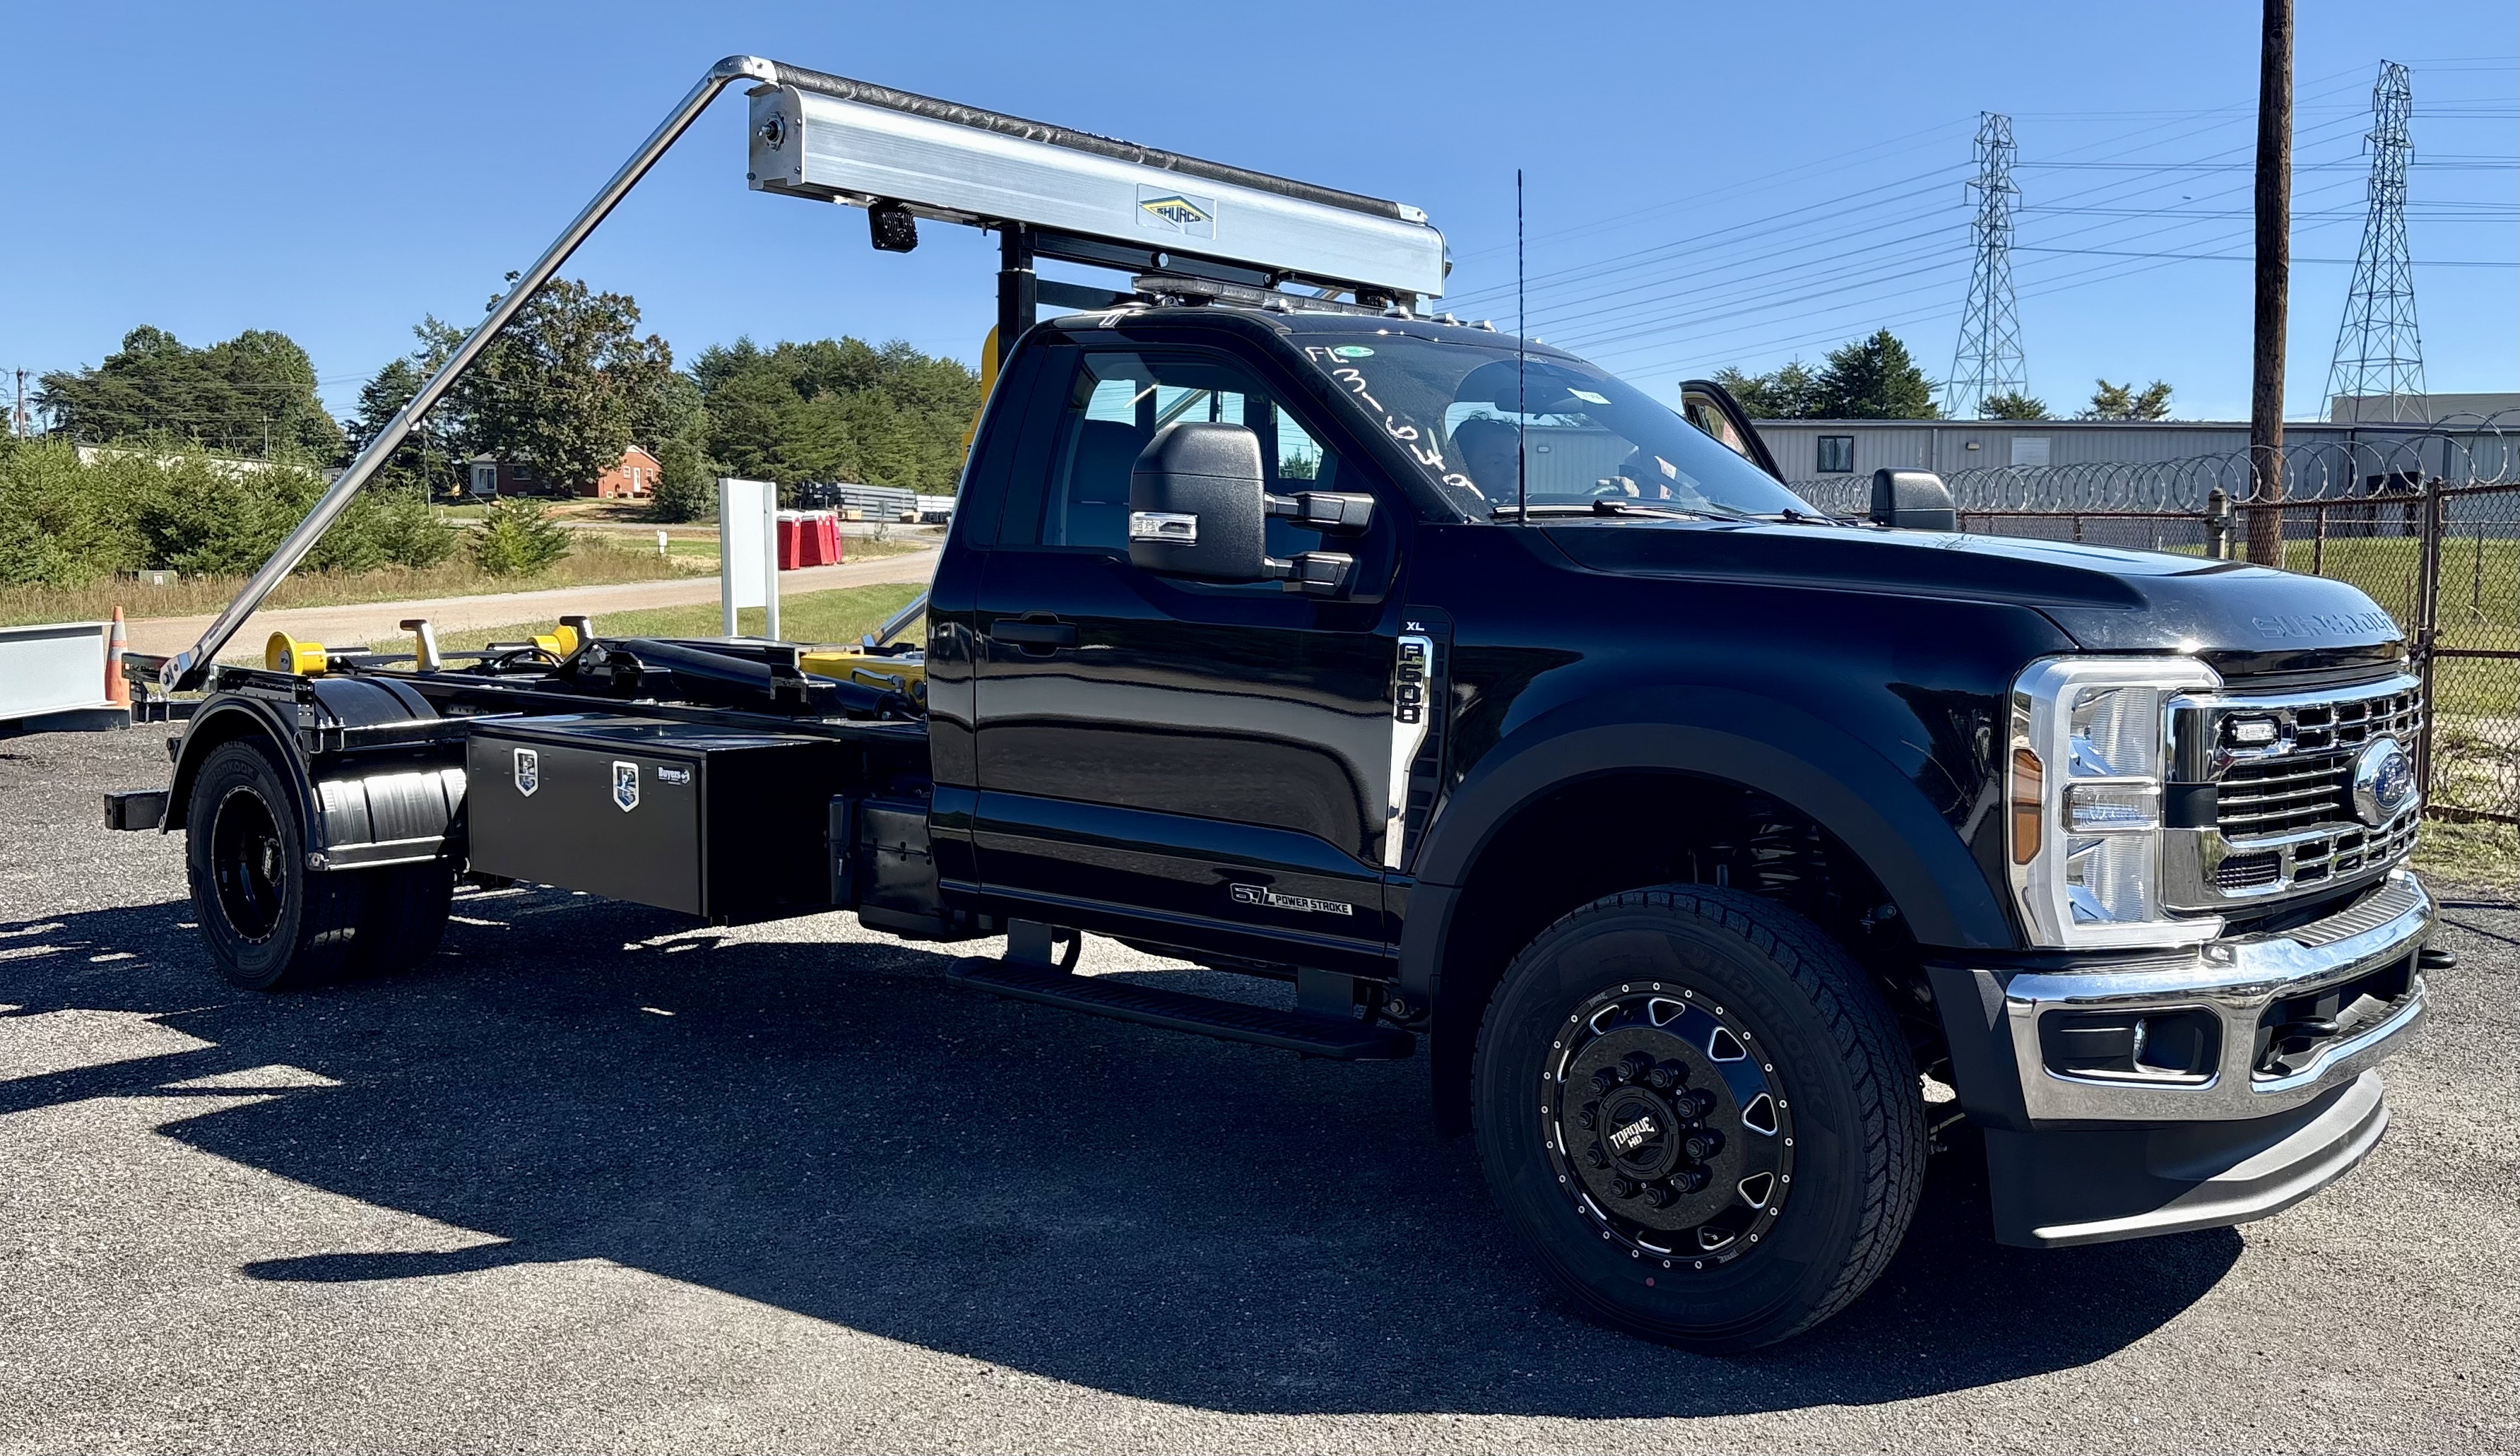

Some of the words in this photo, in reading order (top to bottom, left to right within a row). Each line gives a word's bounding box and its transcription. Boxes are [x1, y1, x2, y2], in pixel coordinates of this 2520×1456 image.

[1305, 346, 1349, 363] FL
[1405, 621, 1425, 631] XL
[658, 767, 681, 780] Buyers
[1275, 894, 1308, 908] POWER
[1311, 900, 1349, 914] STROKE
[1609, 1116, 1655, 1149] TORQUE
[1627, 1135, 1643, 1148] HD
